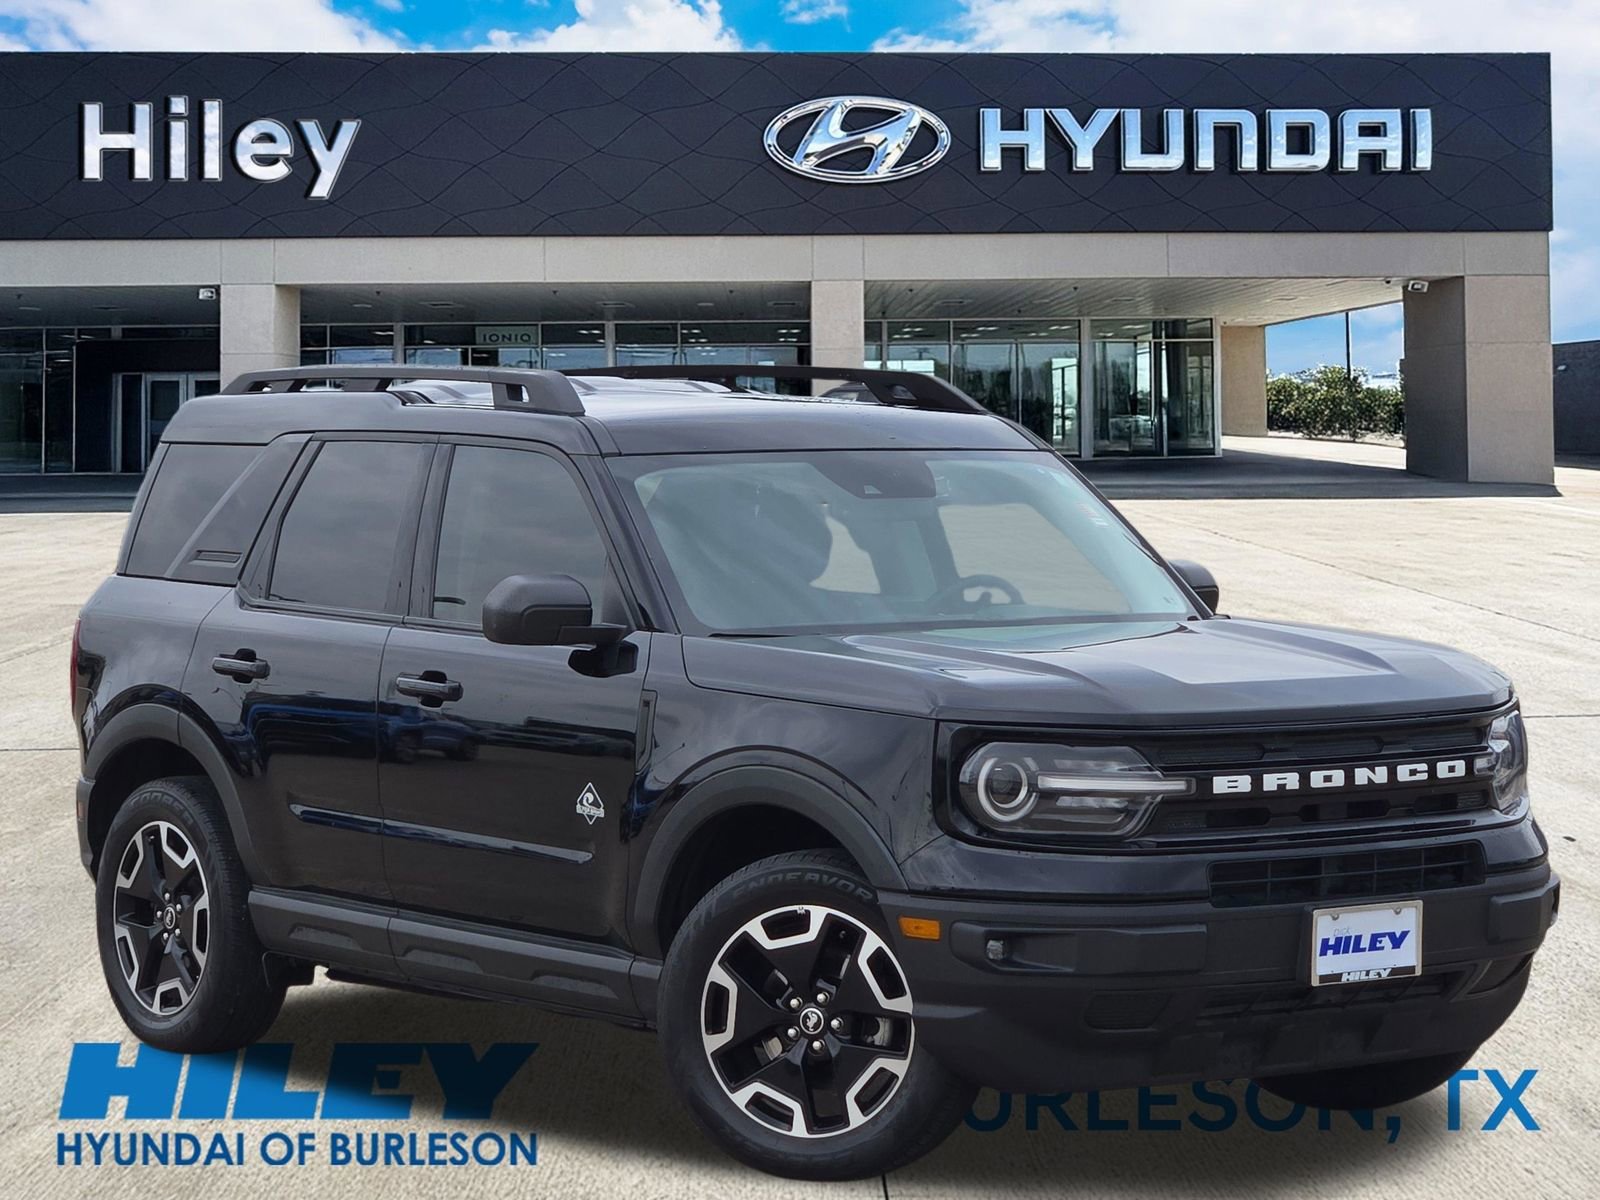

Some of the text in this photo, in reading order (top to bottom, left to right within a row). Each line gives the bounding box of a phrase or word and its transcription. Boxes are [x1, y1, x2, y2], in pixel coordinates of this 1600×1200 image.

[81, 95, 361, 200] Hiley
[980, 107, 1433, 173] HYUNDAI
[1212, 759, 1467, 795] BRONCO
[732, 871, 875, 902] ENDEAVOR
[1319, 930, 1410, 957] HILEY
[1341, 968, 1392, 982] HILEY
